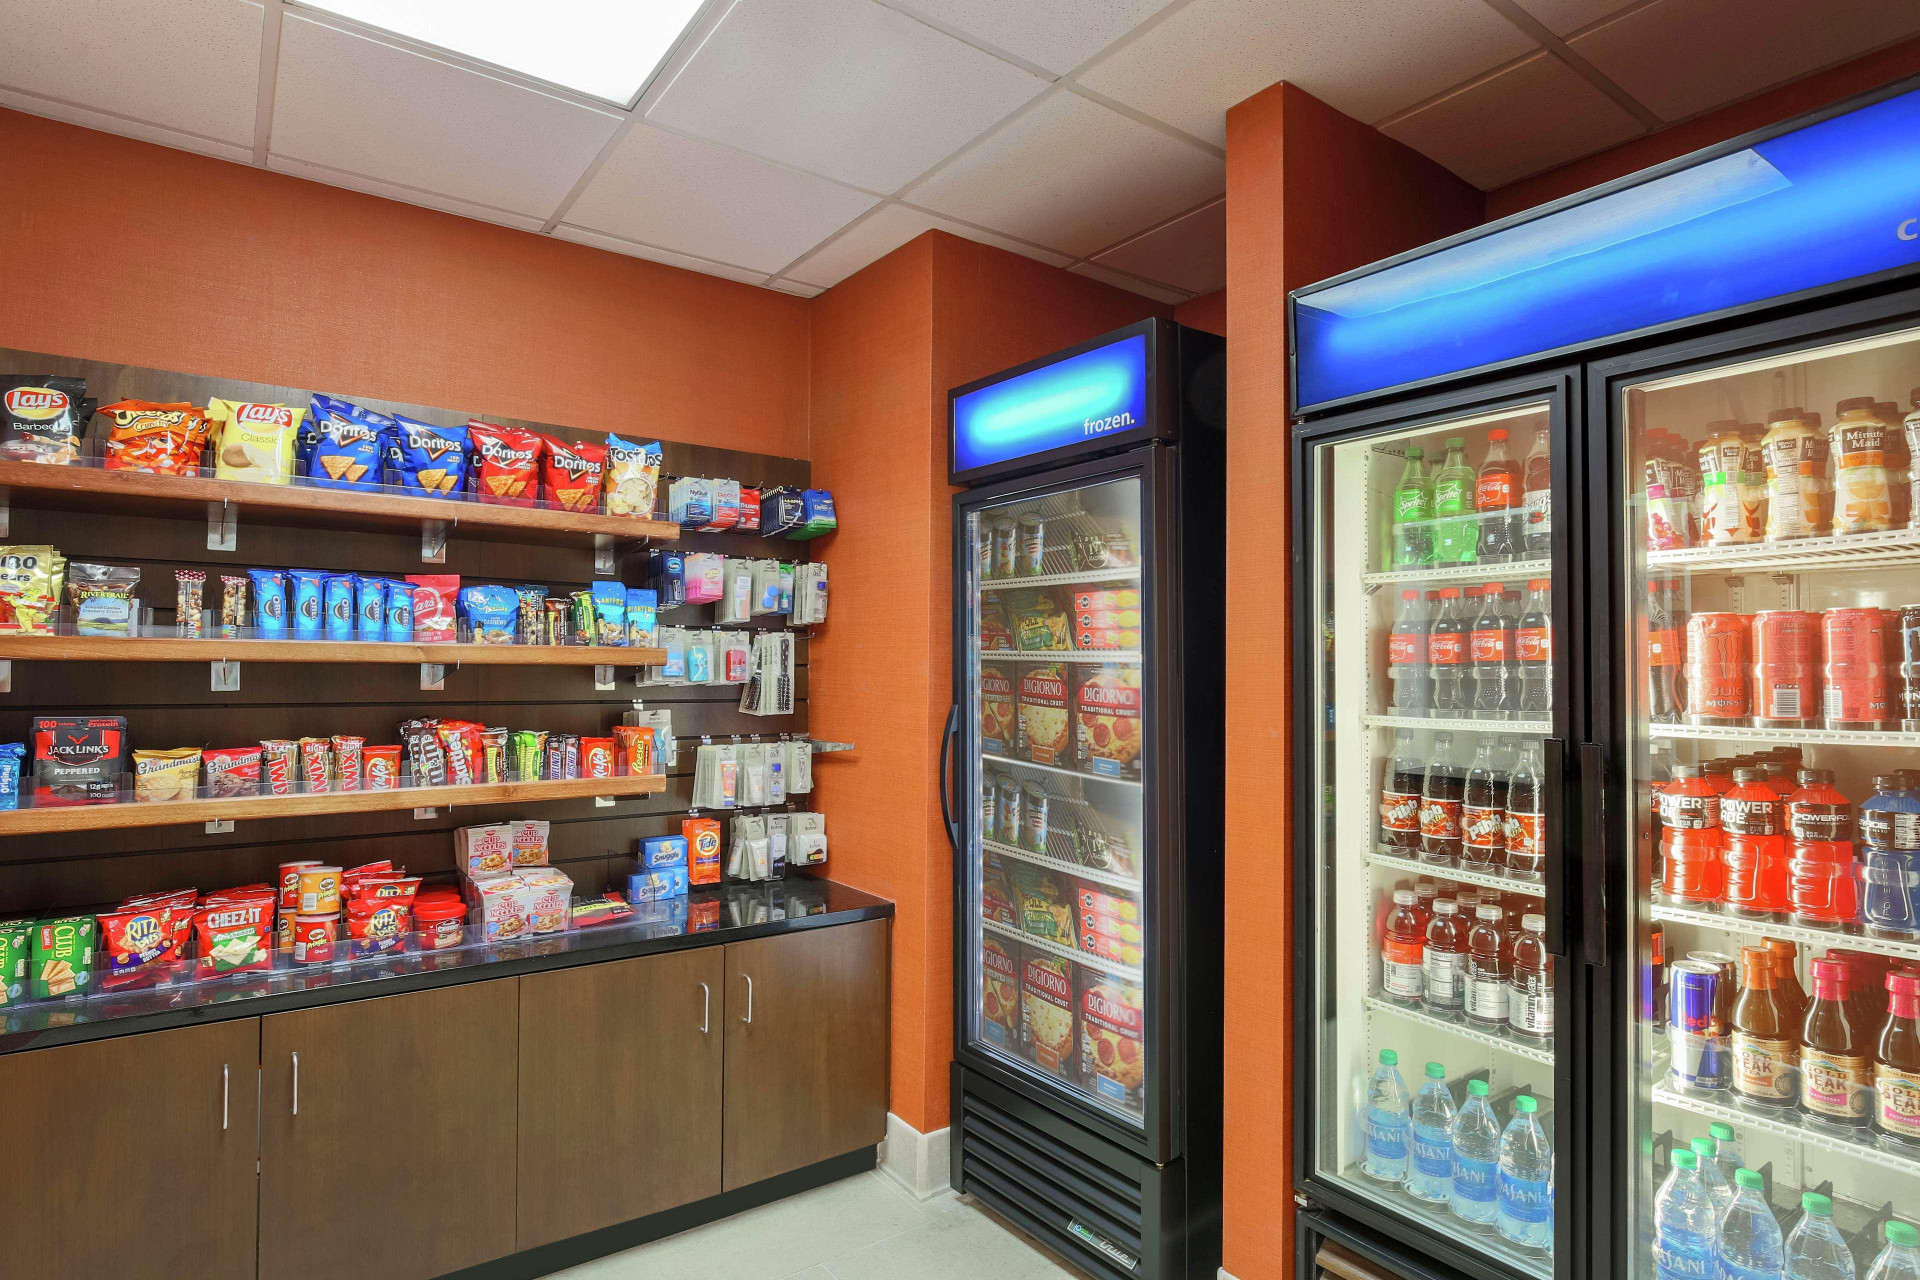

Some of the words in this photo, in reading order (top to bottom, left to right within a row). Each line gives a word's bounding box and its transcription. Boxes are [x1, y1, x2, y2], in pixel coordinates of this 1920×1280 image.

[1897, 217, 1920, 241] c
[11, 391, 64, 410] Lay's
[239, 404, 292, 425] Lay's
[133, 420, 169, 432] Crunchy
[1083, 411, 1136, 436] frozen.
[240, 432, 280, 445] Classic
[320, 420, 378, 443] Doritos
[1846, 430, 1884, 441] Minute
[409, 435, 462, 452] Doritos
[1851, 438, 1881, 449] Maid
[482, 444, 533, 460] Doritos
[554, 455, 601, 473] Doritos
[1400, 497, 1424, 511] Sprite
[1436, 490, 1459, 504] Sprite
[228, 624, 237, 639] IND
[980, 677, 1010, 693] GIORNO
[1021, 695, 1049, 706] TRADITIONAL
[1050, 699, 1064, 707] CRUST
[1081, 705, 1114, 715] TRADITIONAL
[39, 720, 57, 728] 100
[48, 746, 76, 755] JACK
[305, 744, 329, 752] RIGHT
[447, 732, 472, 785] Skittles
[54, 767, 101, 775] PEPPERED
[1387, 799, 1418, 825] Pibb
[1720, 798, 1773, 814] POWER
[1420, 804, 1443, 825] ibb
[521, 829, 539, 837] CUP
[1468, 813, 1502, 841] Pibb
[474, 842, 507, 853] NOODLES
[482, 836, 501, 845] CUP
[698, 838, 718, 852] Tide
[653, 851, 680, 863] Snuggle
[641, 884, 667, 898] Snuggle
[490, 905, 525, 918] NOODLES
[498, 900, 518, 909] CUP
[533, 900, 564, 911] NOODLES
[207, 907, 262, 929] CHEEZ-IT
[370, 911, 397, 931] RITZ
[125, 917, 159, 941] RITZ
[54, 925, 76, 958] CLUB
[306, 937, 328, 951] Pringles
[982, 948, 1013, 974] IGIORNO
[1025, 982, 1054, 1002] TRADITIONAL
[1054, 996, 1069, 1008] CRUST
[1085, 1013, 1118, 1033] TRADITIONAL
[1742, 1051, 1772, 1063] OLD
[1743, 1060, 1773, 1074] EAK
[1810, 1091, 1841, 1103] RASPBERRY
[1368, 1125, 1400, 1144] ASANI
[1452, 1161, 1486, 1185] ASANI
[1656, 1248, 1707, 1275] ASANI
